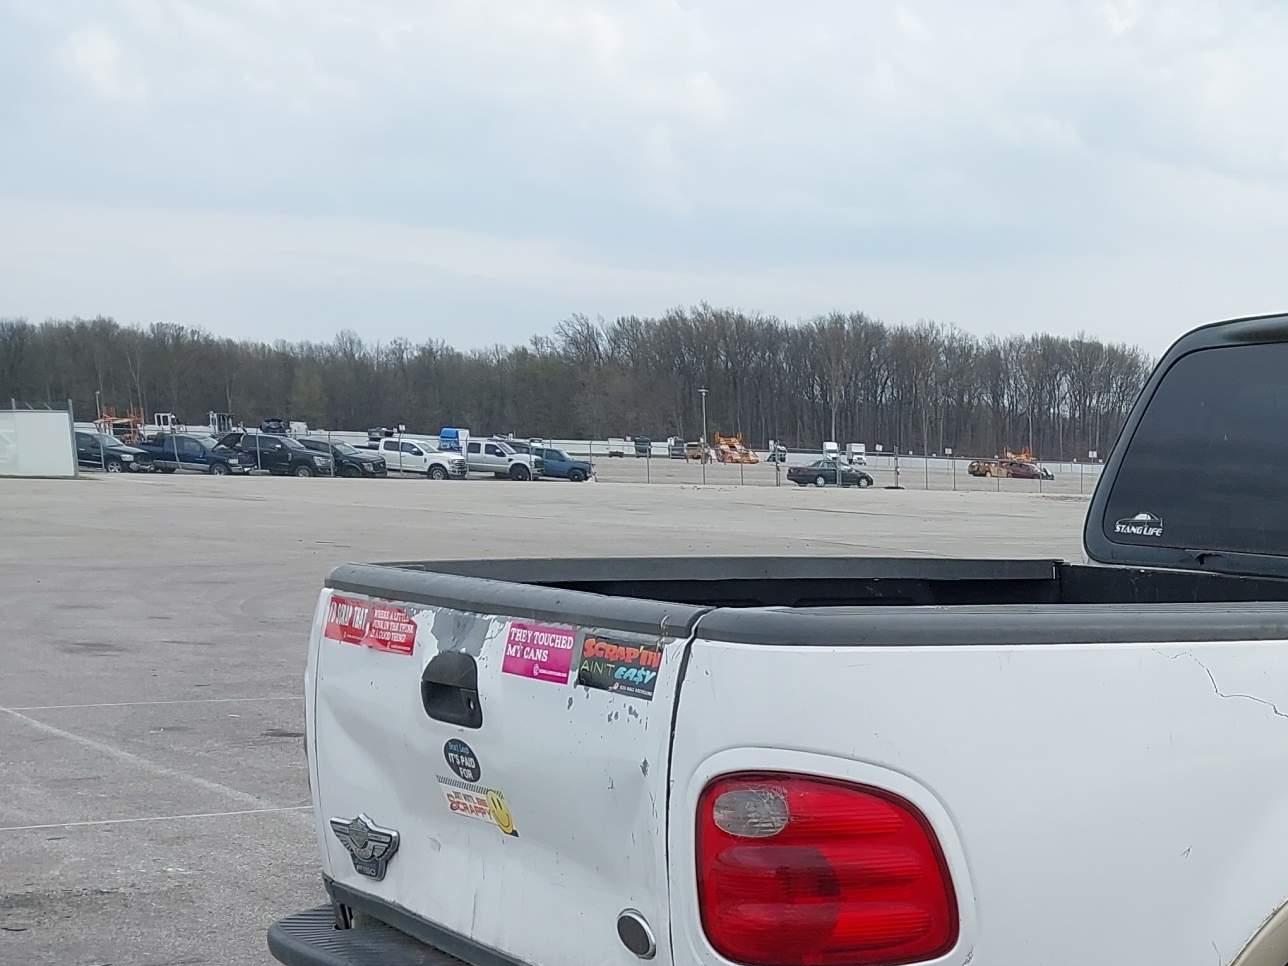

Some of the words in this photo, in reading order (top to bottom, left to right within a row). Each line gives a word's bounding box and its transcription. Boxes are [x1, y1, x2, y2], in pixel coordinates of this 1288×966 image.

[1114, 524, 1143, 535] STANG
[1143, 526, 1163, 536] LIFE
[510, 627, 533, 643] THEY
[533, 631, 574, 649] TOUCHED
[506, 643, 523, 658] MY
[523, 646, 549, 662] CANS
[580, 659, 615, 677] AIN'T
[460, 755, 476, 769] PAID
[459, 766, 474, 780] FOR
